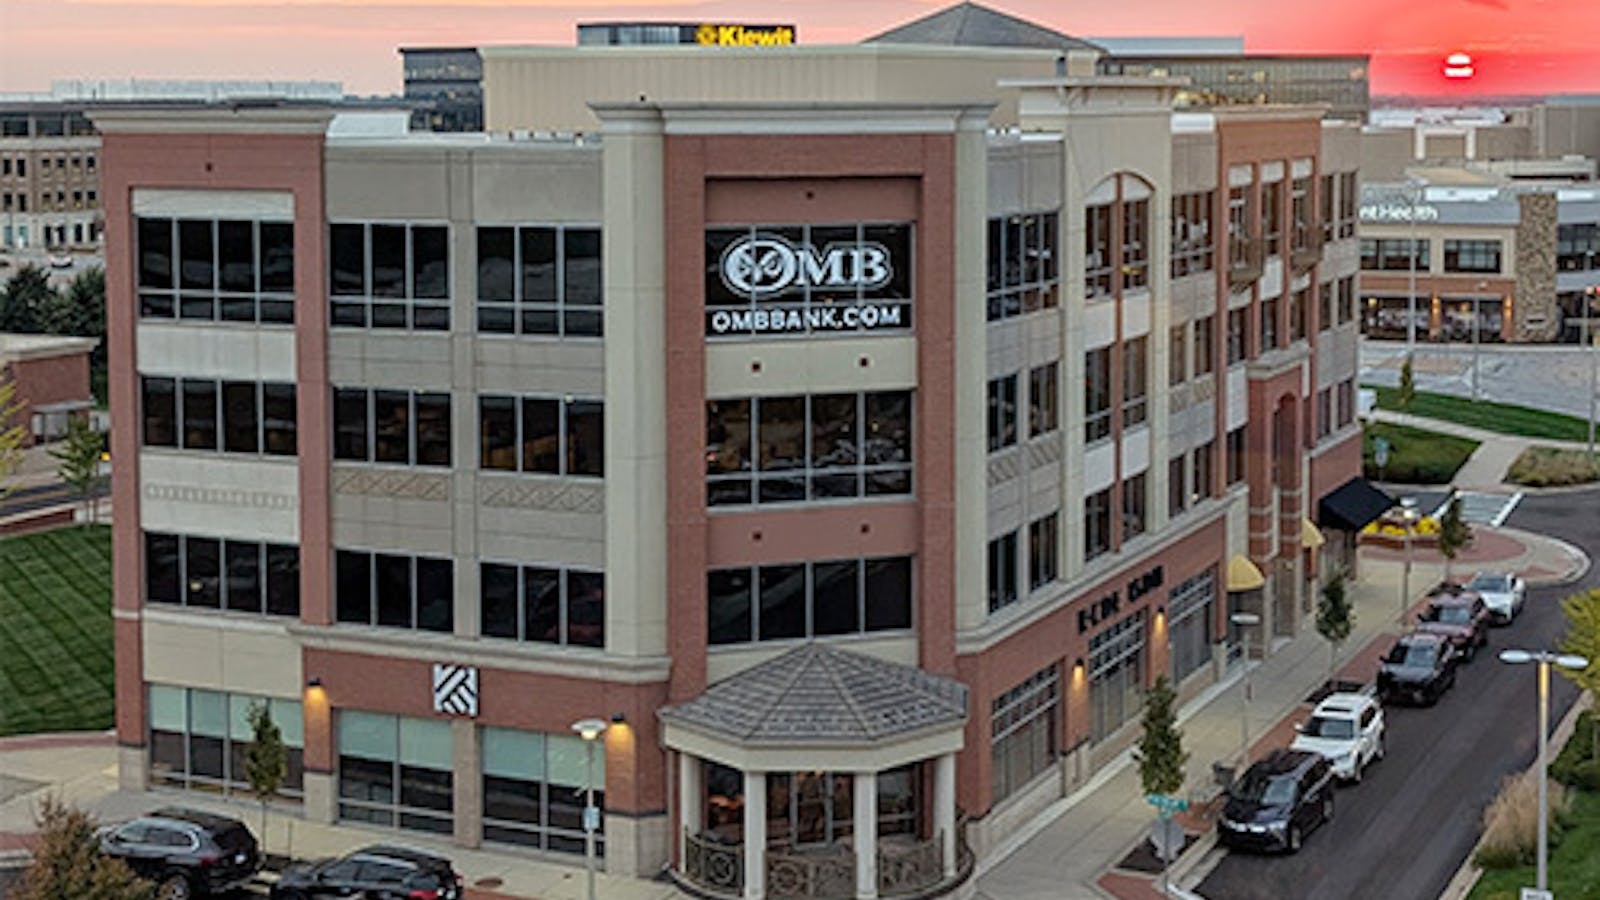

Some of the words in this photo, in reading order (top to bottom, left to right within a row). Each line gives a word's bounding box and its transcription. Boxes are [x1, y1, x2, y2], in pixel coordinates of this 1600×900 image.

[719, 26, 792, 46] Kiewit
[722, 237, 890, 294] OMB
[711, 304, 901, 333] OMBBANK.COM
